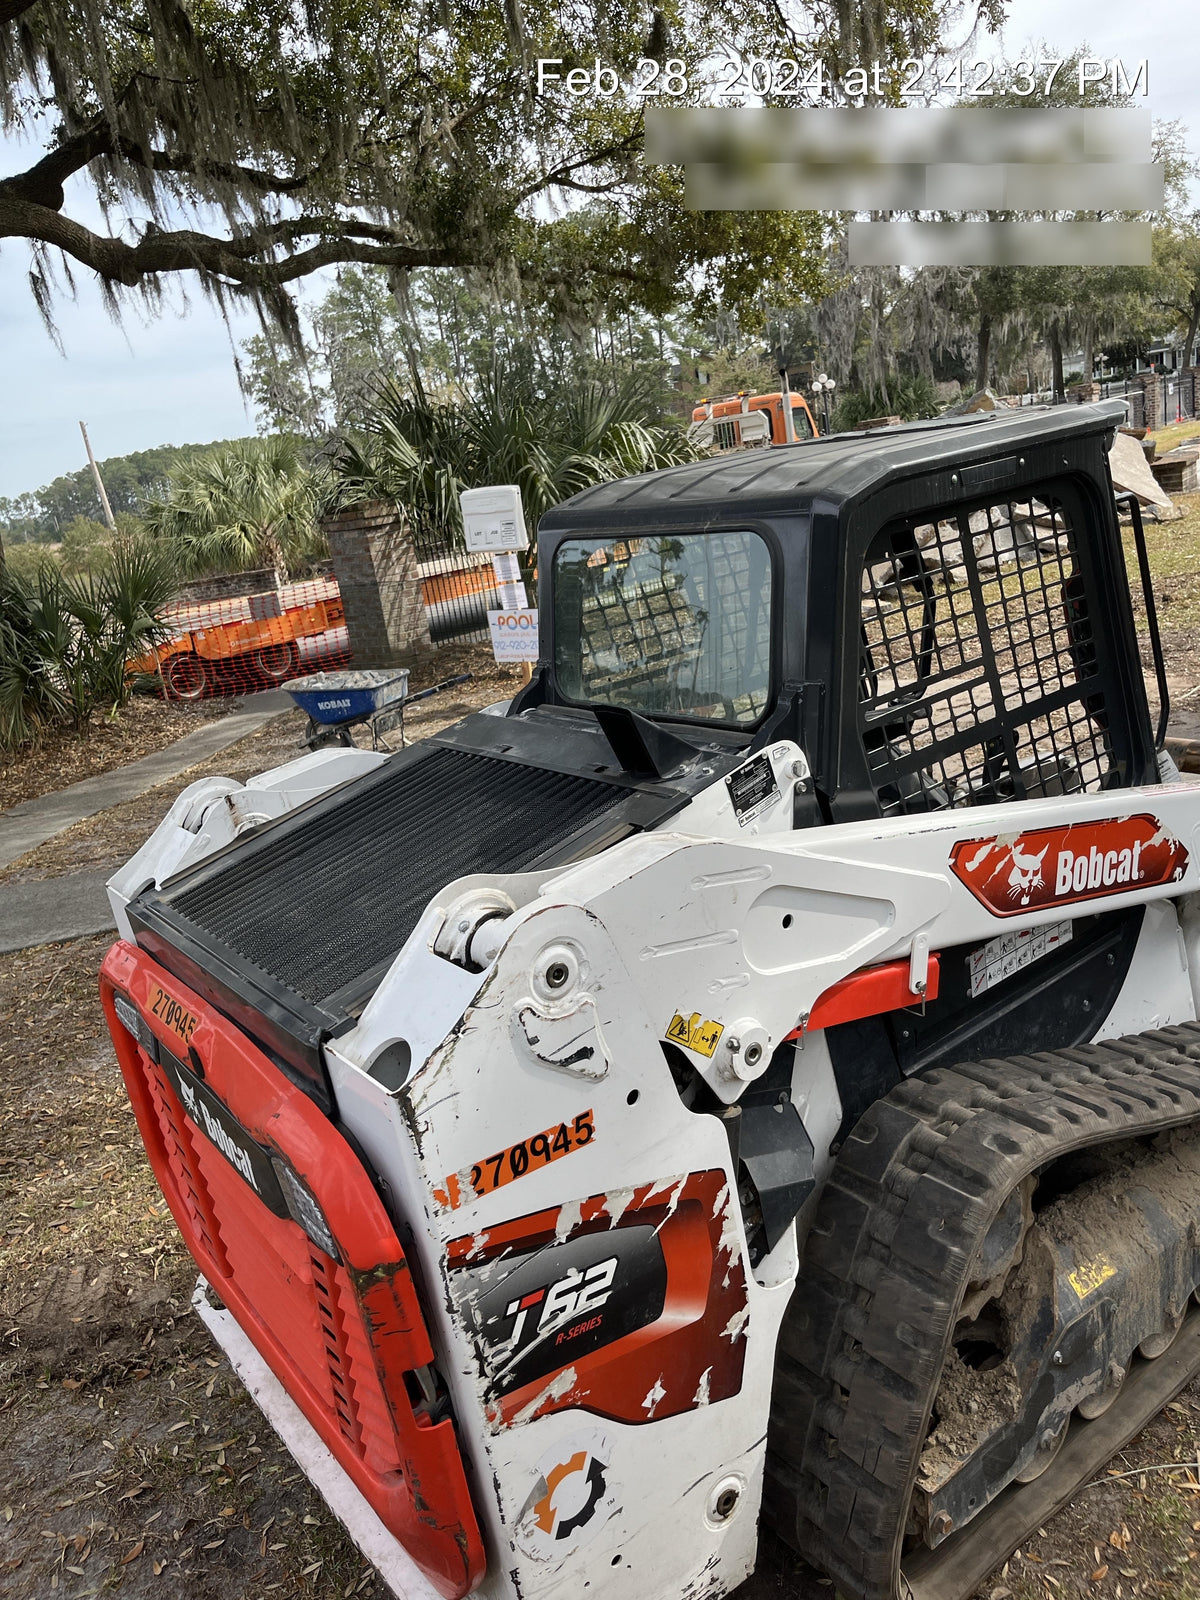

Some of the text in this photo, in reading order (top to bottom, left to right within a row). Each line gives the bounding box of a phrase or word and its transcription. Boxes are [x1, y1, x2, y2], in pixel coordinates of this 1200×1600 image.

[498, 614, 537, 630] POOL
[317, 699, 351, 710] KOBALT
[1055, 840, 1141, 896] Bobcat
[152, 989, 196, 1044] 270945
[199, 1099, 260, 1191] Bobcat
[471, 1111, 593, 1195] 270945
[506, 1257, 618, 1348] T62
[555, 1314, 603, 1346] R-SERIES
